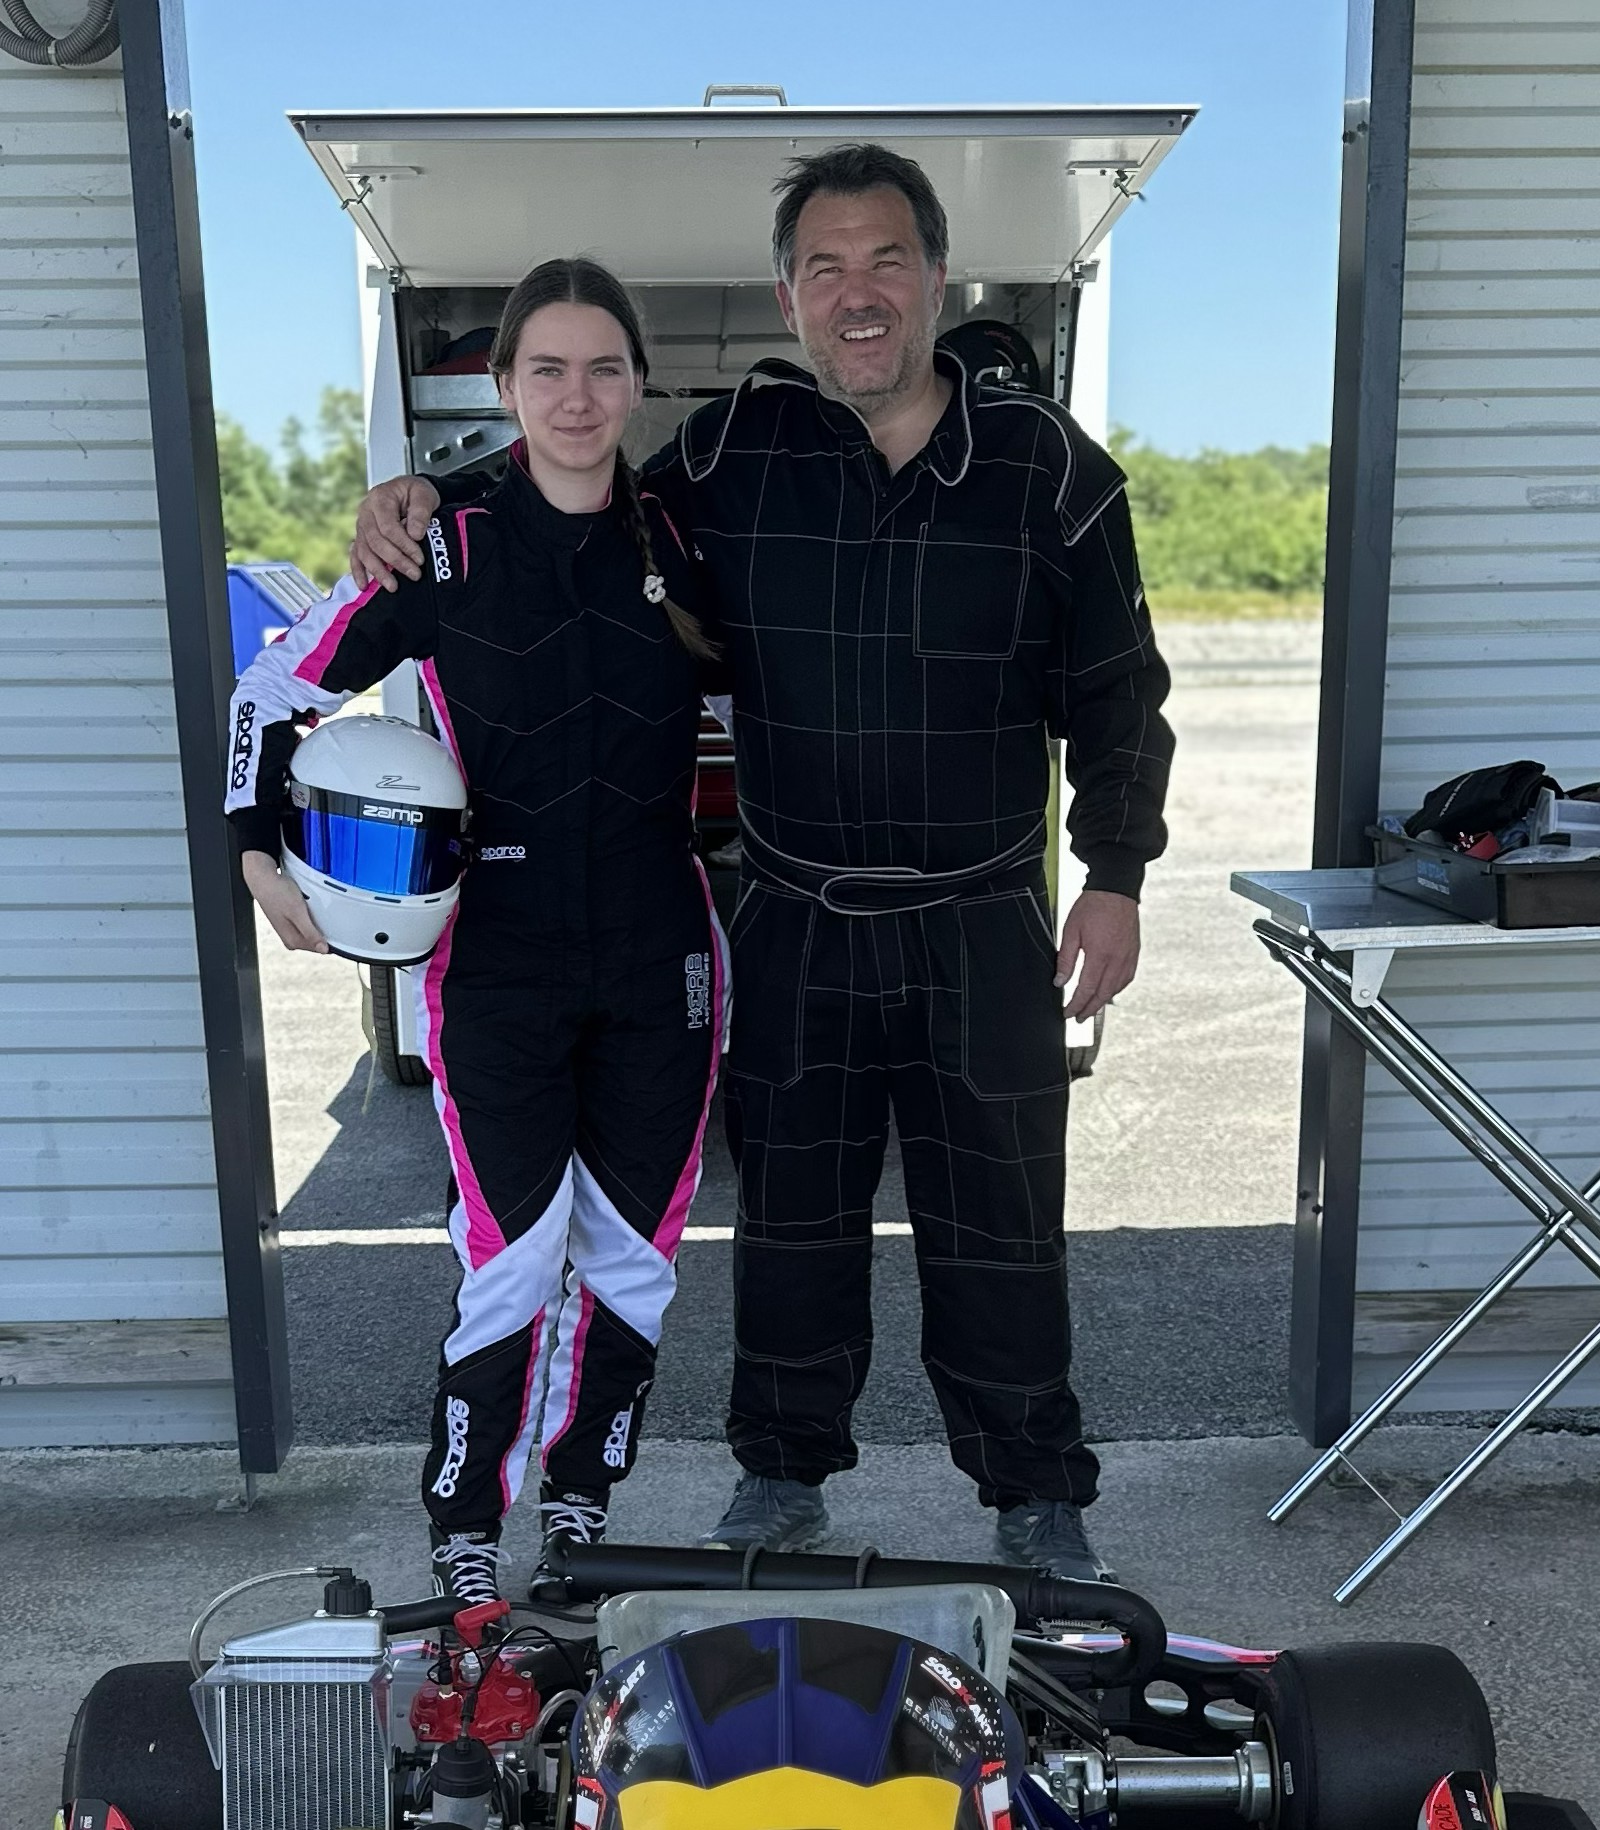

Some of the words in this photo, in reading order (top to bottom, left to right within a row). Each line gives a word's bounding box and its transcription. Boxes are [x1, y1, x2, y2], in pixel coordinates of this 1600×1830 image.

[231, 701, 256, 792] sparco
[363, 803, 423, 825] zamp
[480, 845, 526, 860] sparco
[431, 1395, 470, 1498] sparco
[905, 1697, 962, 1760] BEAULIEU
[923, 1656, 993, 1737] SOLOKART
